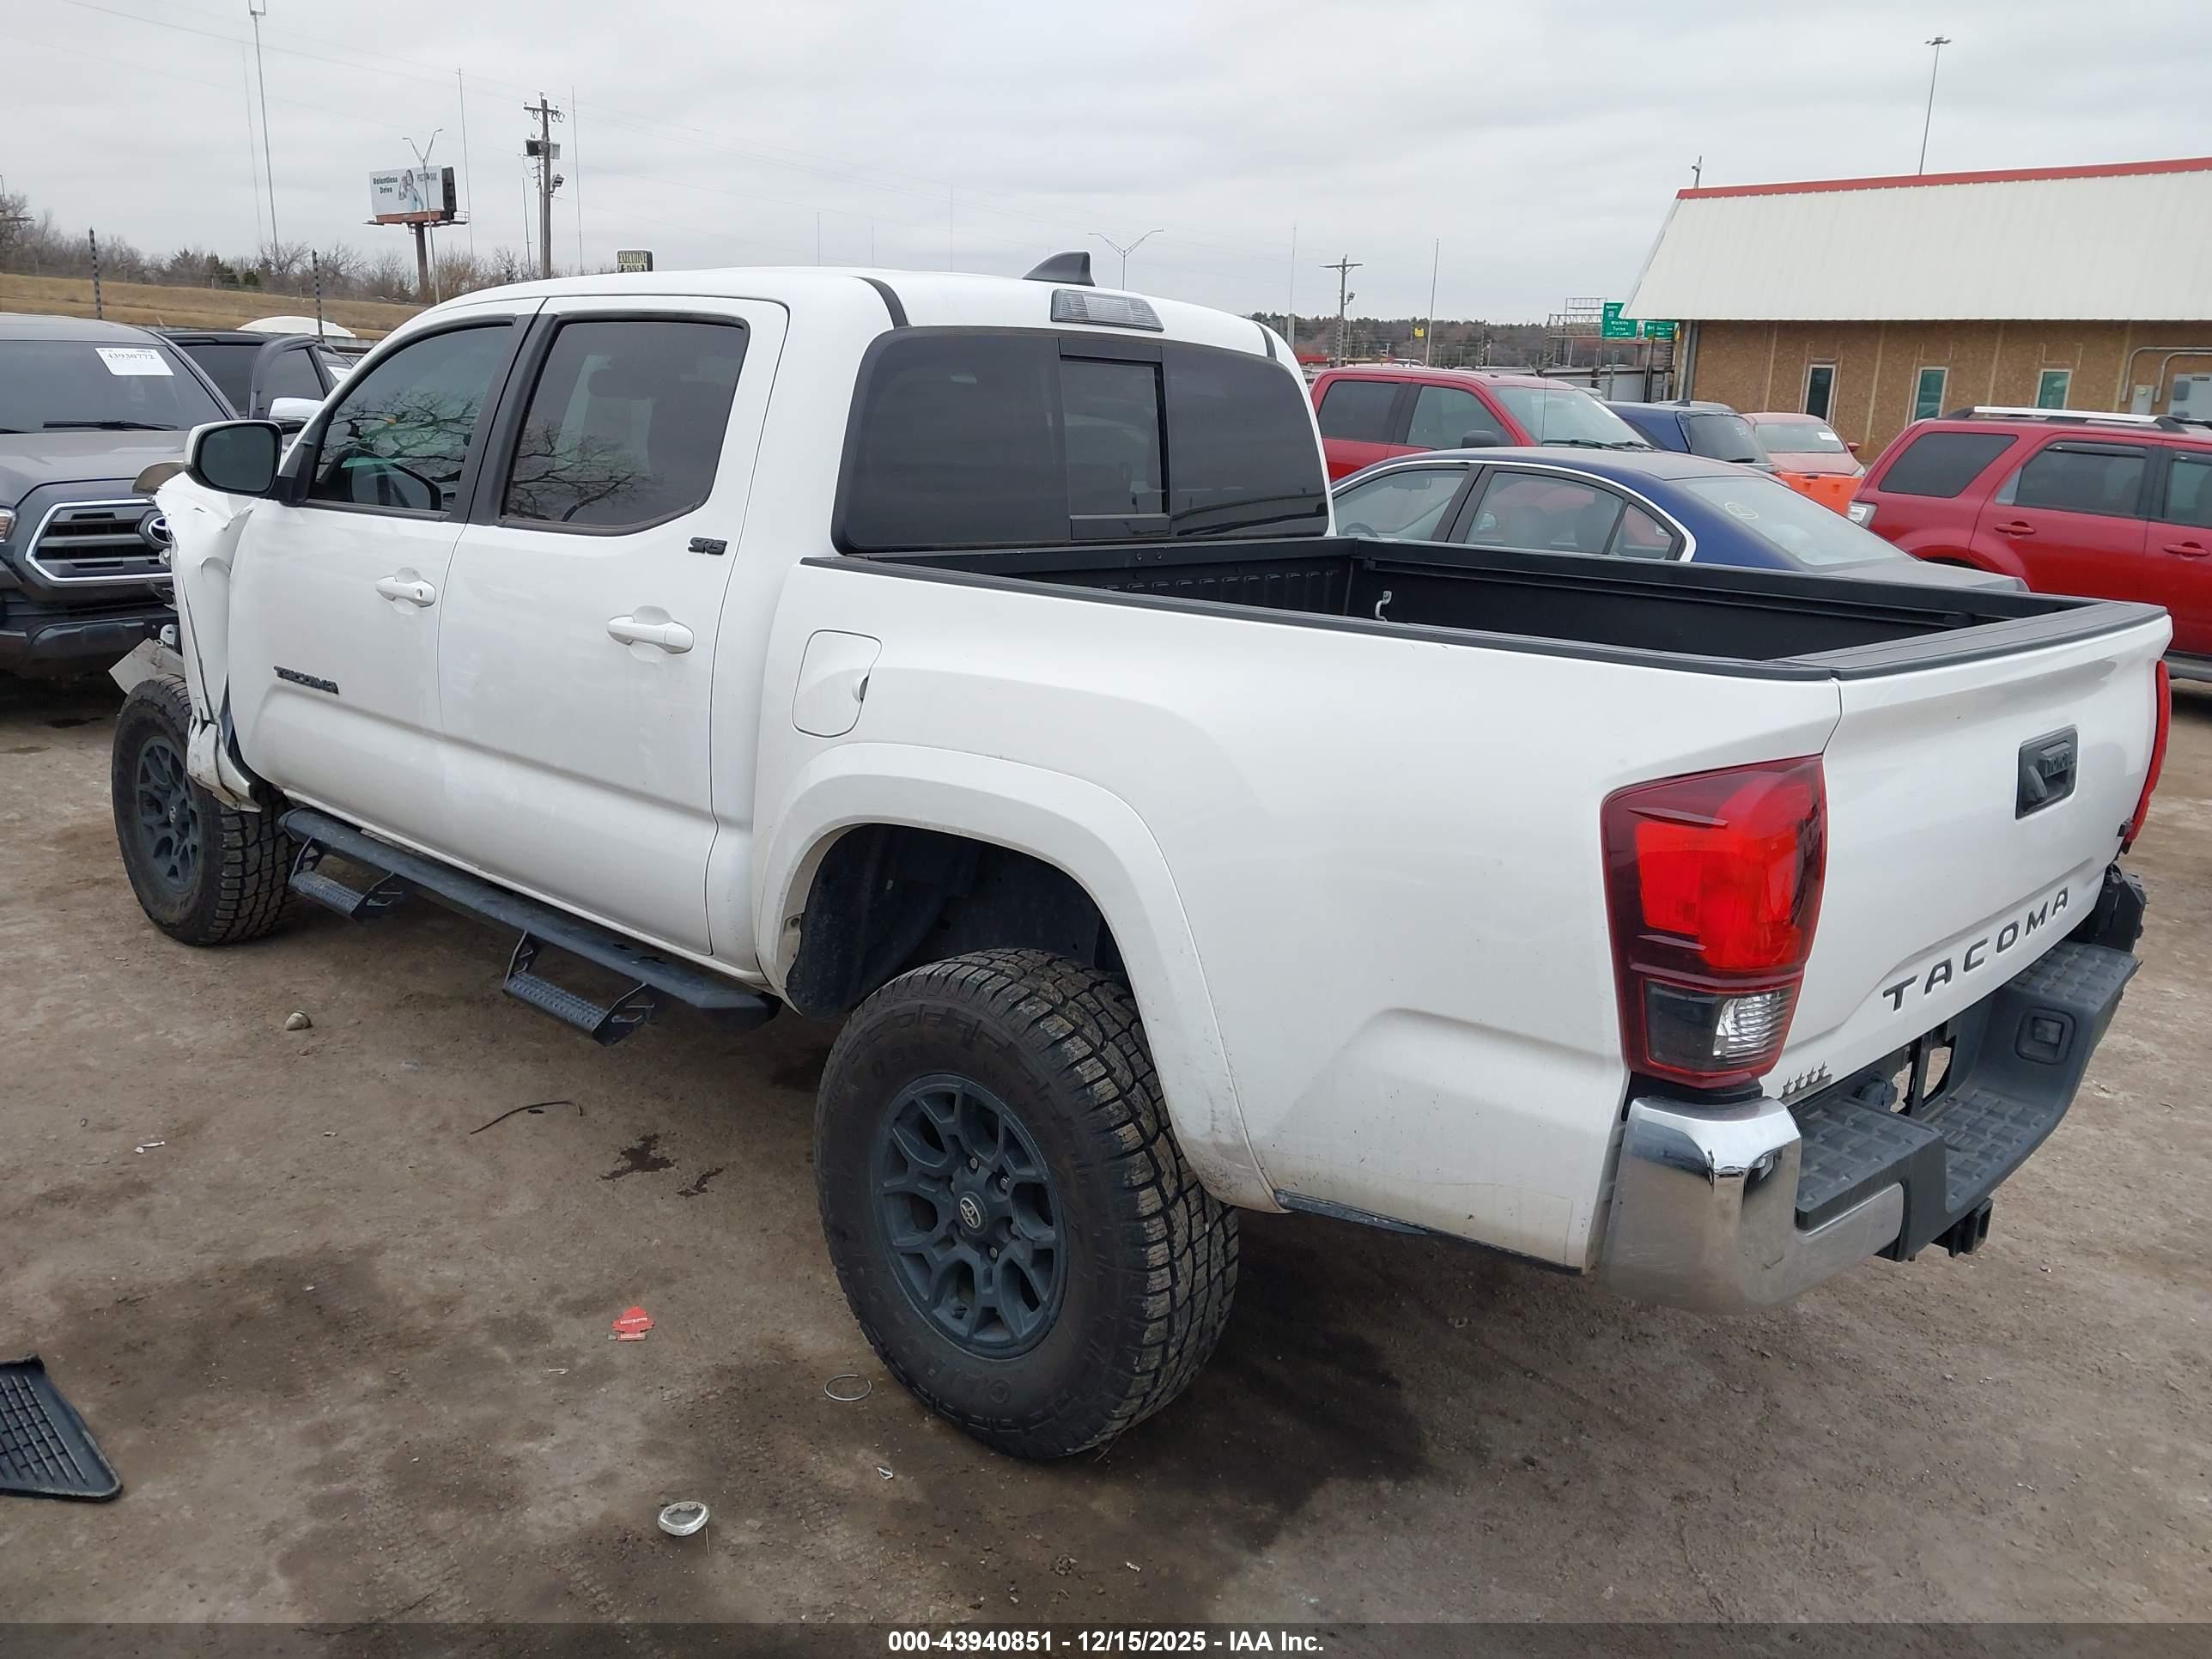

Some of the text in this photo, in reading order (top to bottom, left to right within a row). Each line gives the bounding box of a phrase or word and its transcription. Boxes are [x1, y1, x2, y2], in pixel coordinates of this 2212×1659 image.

[373, 177, 398, 185] Relentless
[618, 252, 647, 264] EXECUTIVE
[687, 537, 728, 556] SR5
[1881, 886, 2069, 1012] TACOMA
